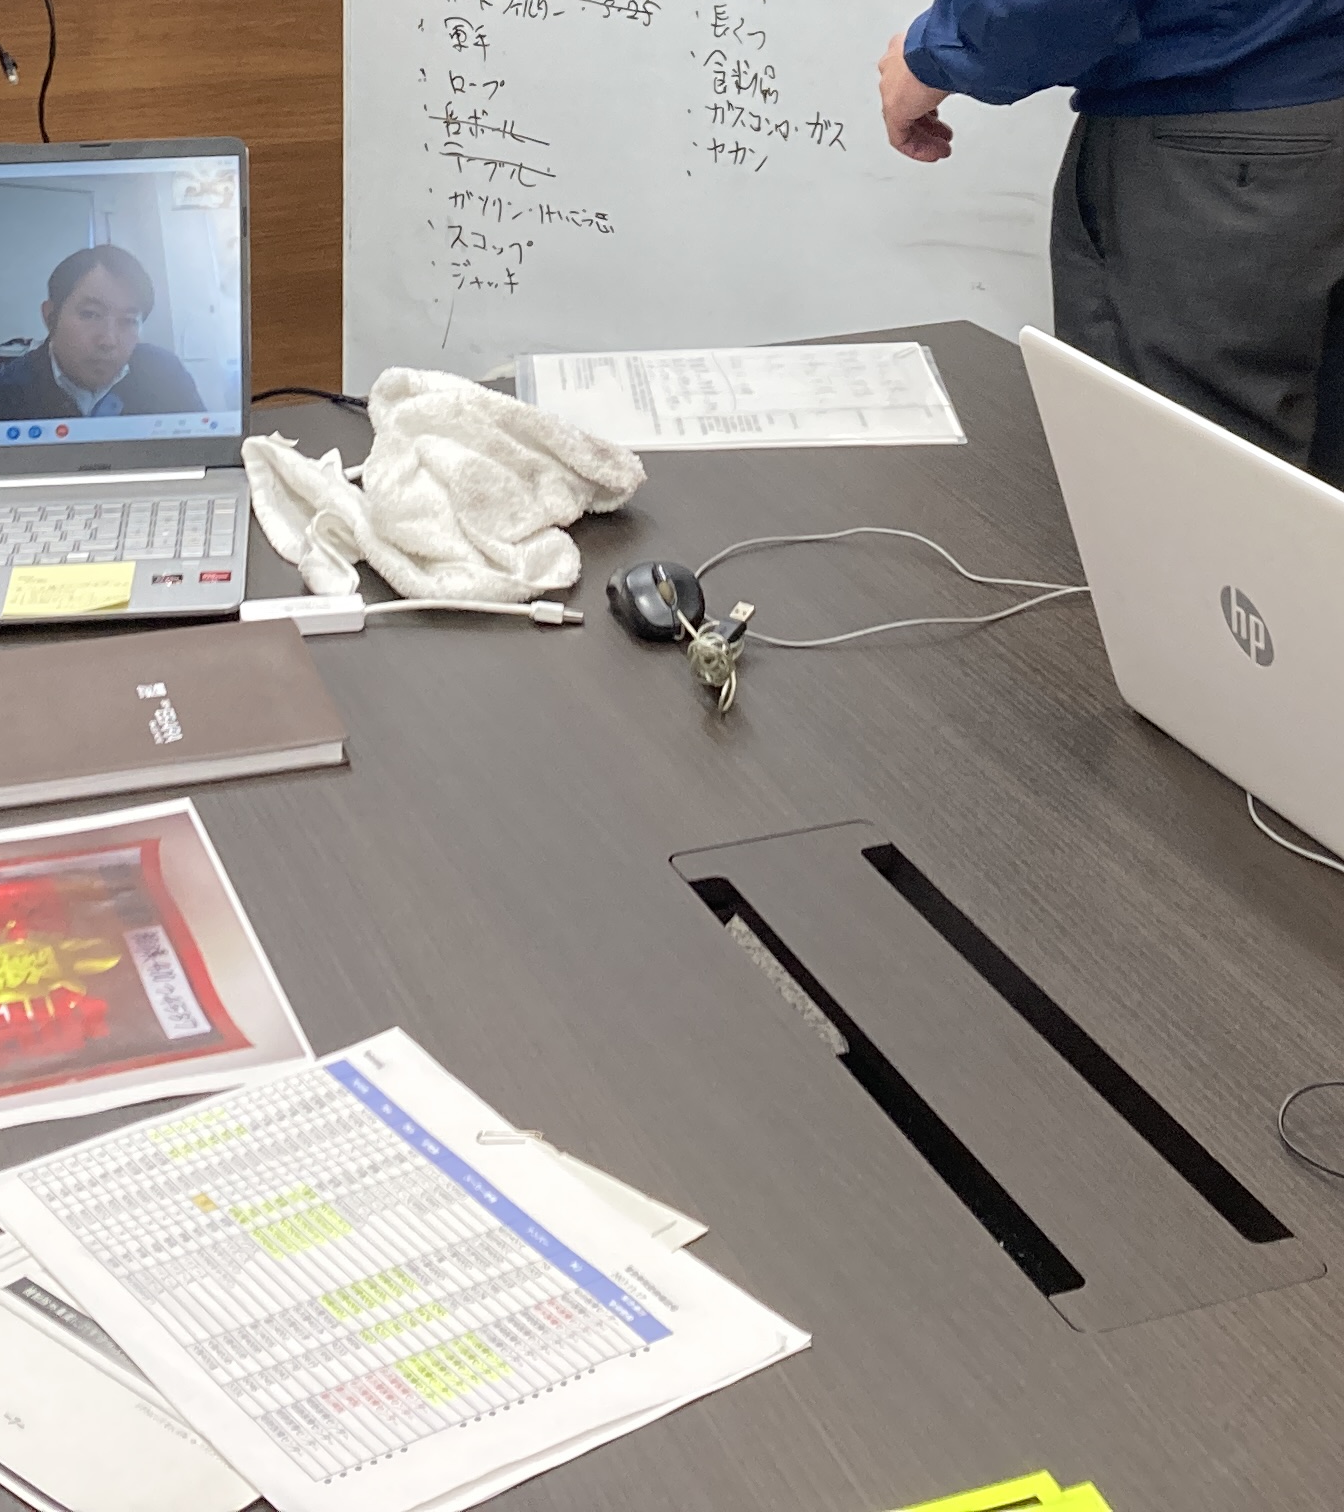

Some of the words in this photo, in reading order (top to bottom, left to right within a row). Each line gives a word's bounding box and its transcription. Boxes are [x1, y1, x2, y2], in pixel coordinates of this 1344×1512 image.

[448, 69, 507, 102] ロープ
[704, 49, 780, 106] 食料品
[706, 140, 769, 173] ヤカン
[447, 224, 535, 265] スコップ
[450, 258, 520, 295] ジャッキ
[1224, 585, 1272, 668] hp
